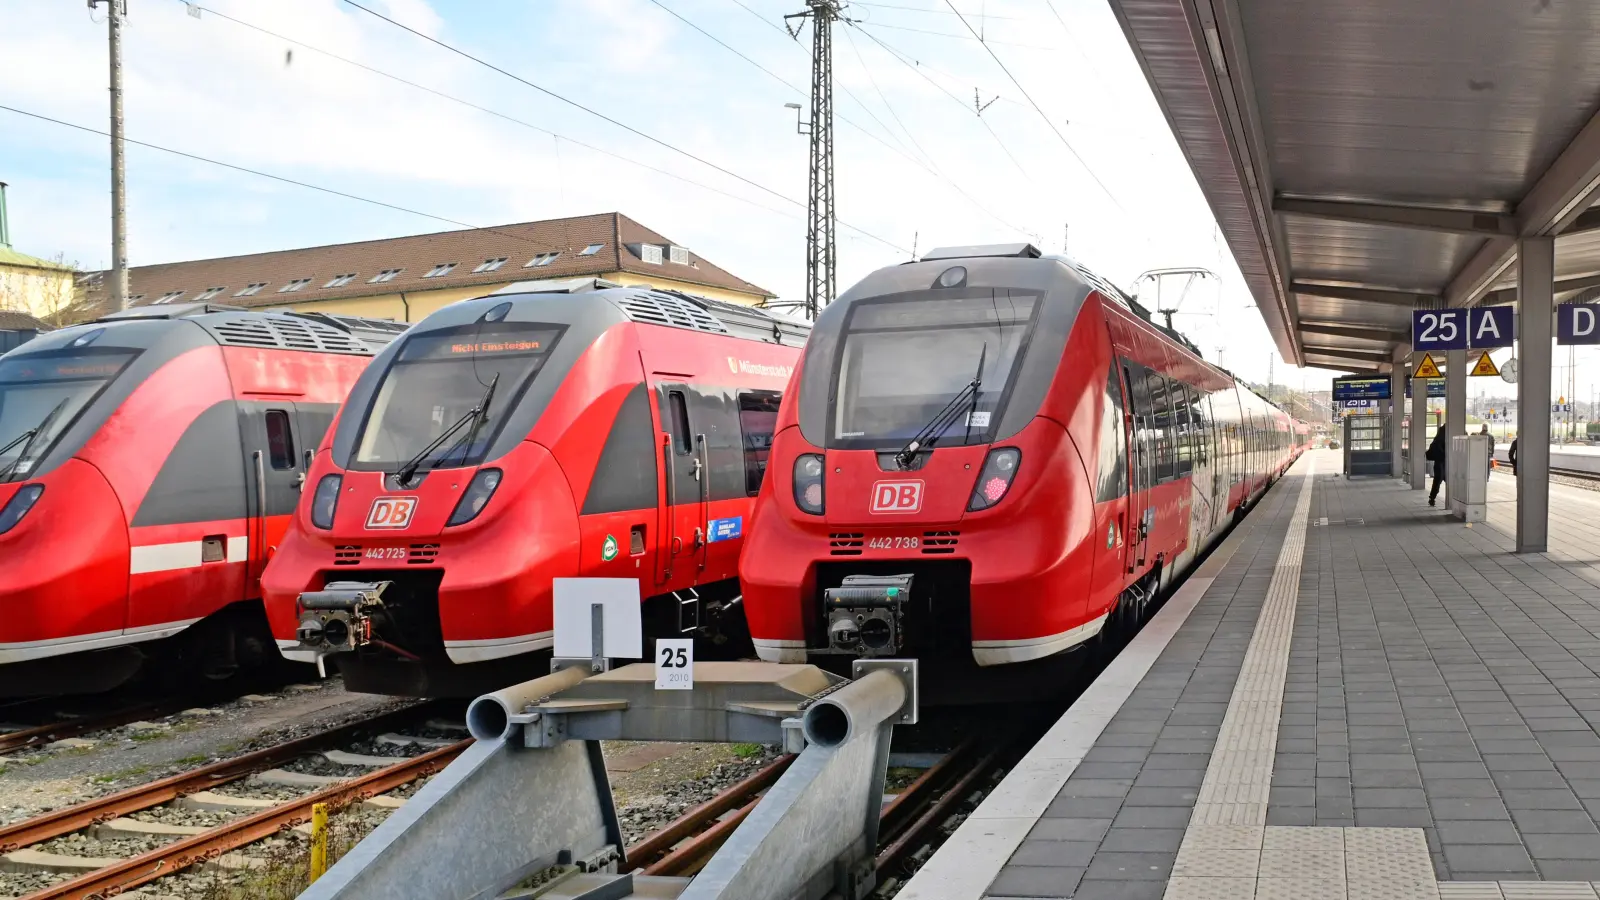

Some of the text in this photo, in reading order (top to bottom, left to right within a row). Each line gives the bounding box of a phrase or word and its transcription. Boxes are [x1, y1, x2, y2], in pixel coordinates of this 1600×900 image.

[1419, 310, 1500, 342] 25 A
[1573, 307, 1595, 336] D
[452, 341, 540, 352] Nicht Einsteigen
[871, 485, 917, 508] DB
[371, 502, 410, 524] DB
[365, 547, 406, 559] 442 725
[869, 536, 919, 549] 442 738
[661, 647, 688, 668] 25
[669, 673, 689, 682] 2010
